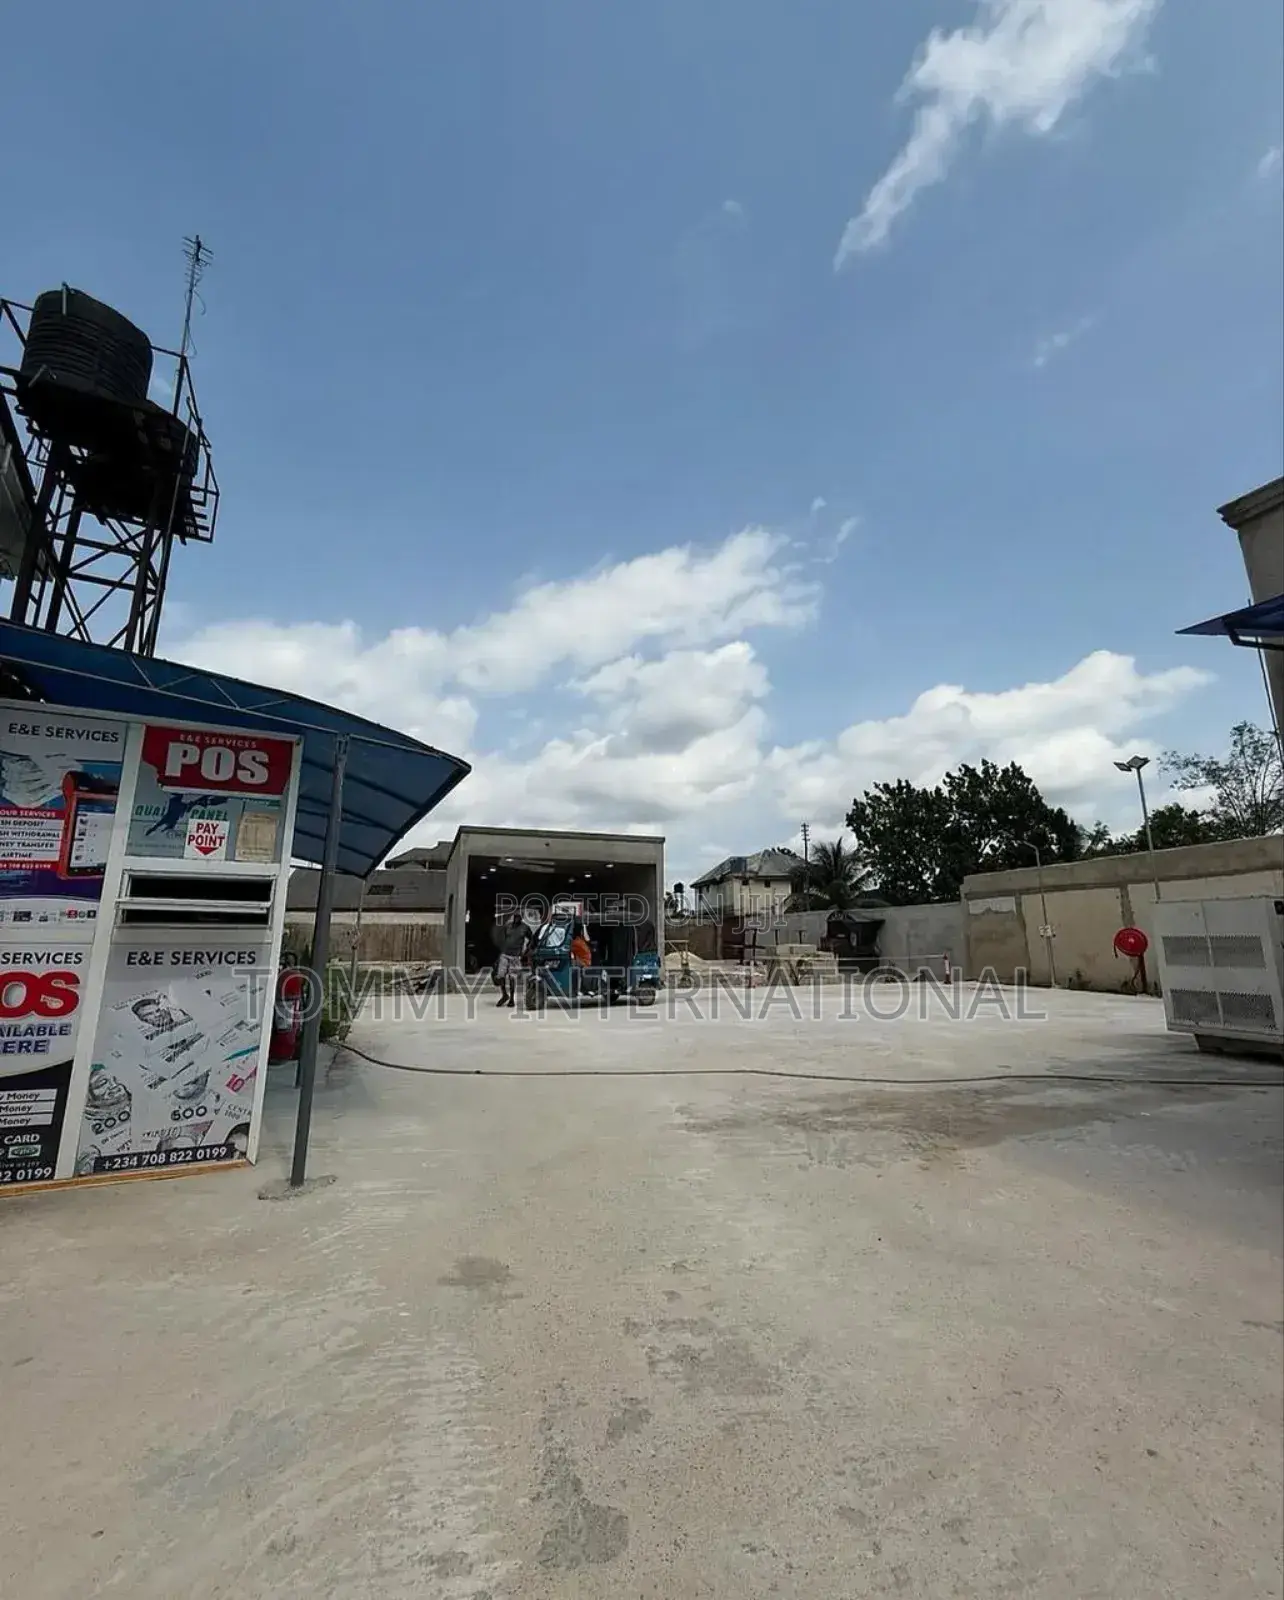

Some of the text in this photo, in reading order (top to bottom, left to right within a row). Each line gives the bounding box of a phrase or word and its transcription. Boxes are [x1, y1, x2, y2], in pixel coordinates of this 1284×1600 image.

[8, 723, 119, 743] E&E SERVICES
[179, 734, 257, 748] E&E SERVICES
[165, 743, 269, 784] POS
[196, 823, 219, 835] PAY
[187, 835, 226, 847] POINT
[1, 952, 83, 965] SERVICES
[127, 951, 256, 966] E&E SERVICES
[0, 971, 80, 1018] OS
[0, 1040, 50, 1054] ERE
[7, 1093, 40, 1101] Money
[0, 1105, 33, 1113] Money
[4, 1134, 40, 1145] CARD
[103, 1146, 227, 1170] +234 708 822 0199
[0, 1167, 52, 1181] 2 0199
